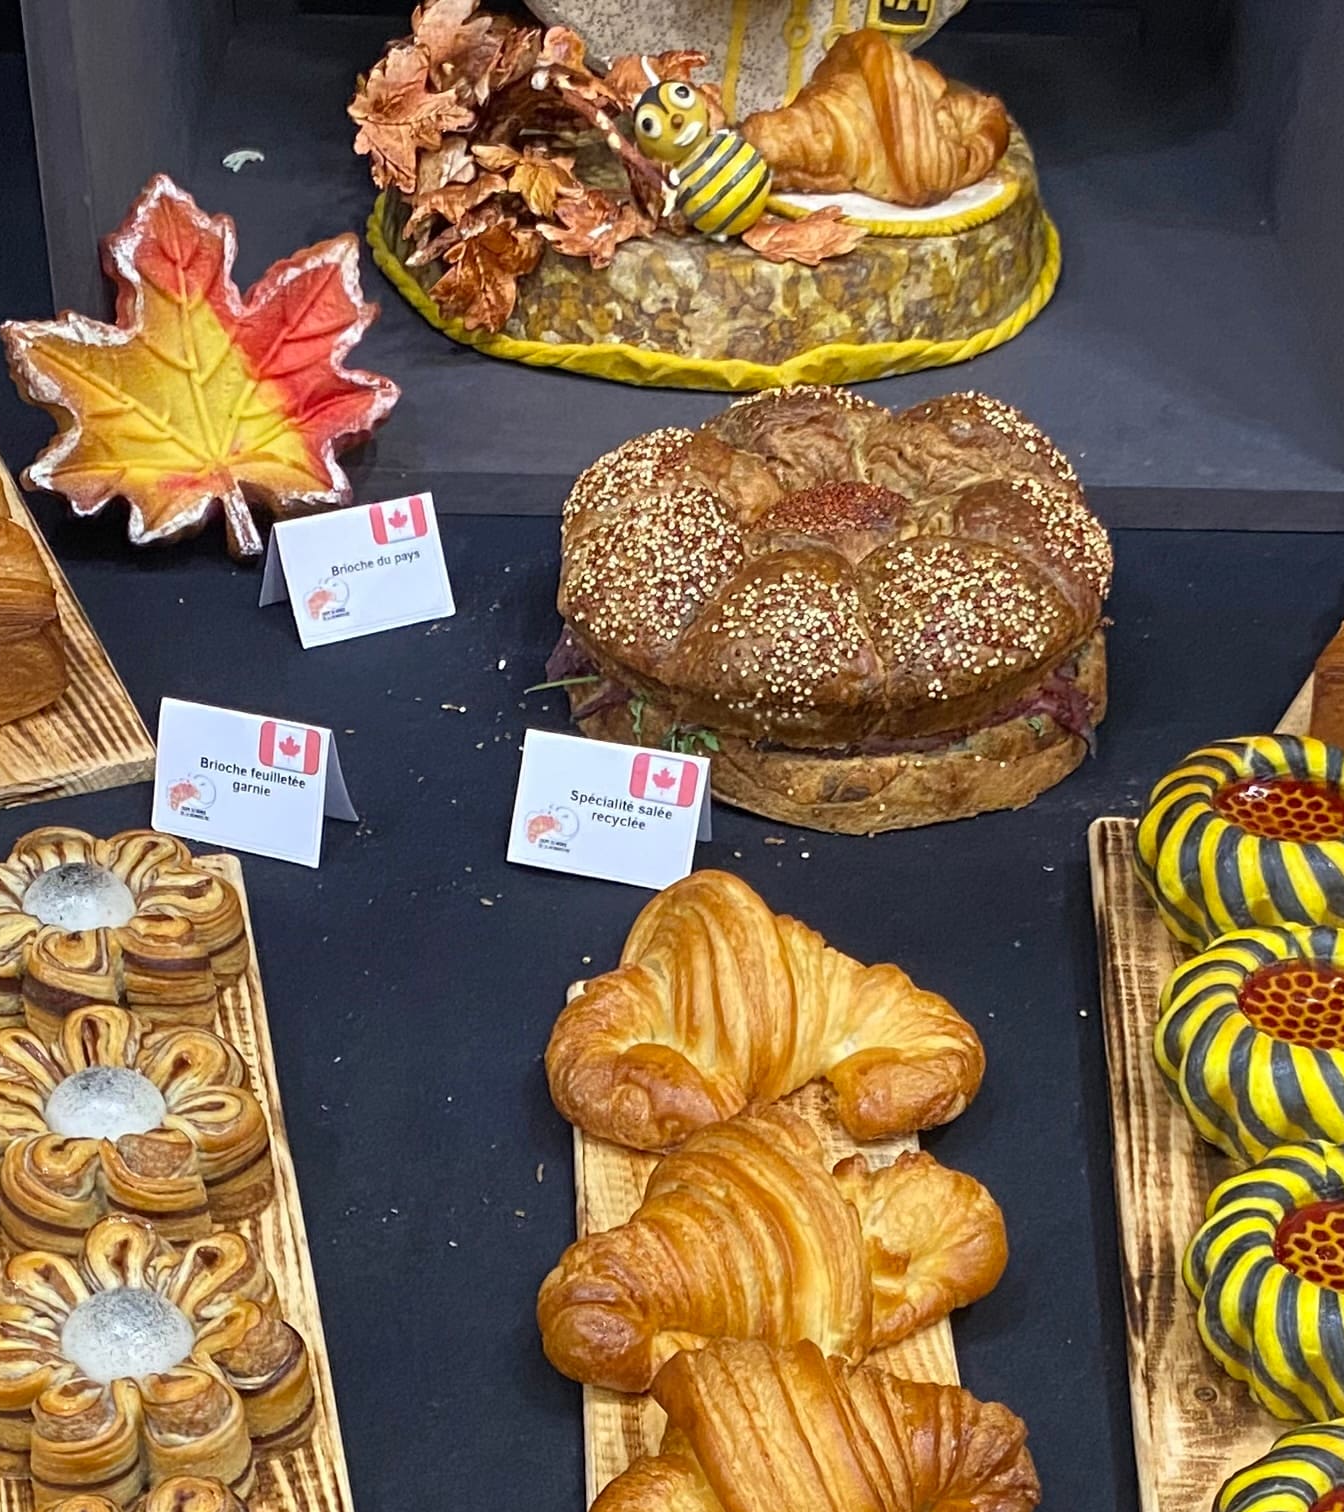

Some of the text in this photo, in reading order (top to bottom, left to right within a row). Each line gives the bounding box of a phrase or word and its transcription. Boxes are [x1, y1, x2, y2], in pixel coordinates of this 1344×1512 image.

[331, 550, 421, 577] Brioche du pays
[200, 757, 306, 789] Brioche feuilletée
[232, 781, 271, 797] garnie
[570, 791, 673, 821] Spécialité salée
[591, 811, 646, 830] recyclée
